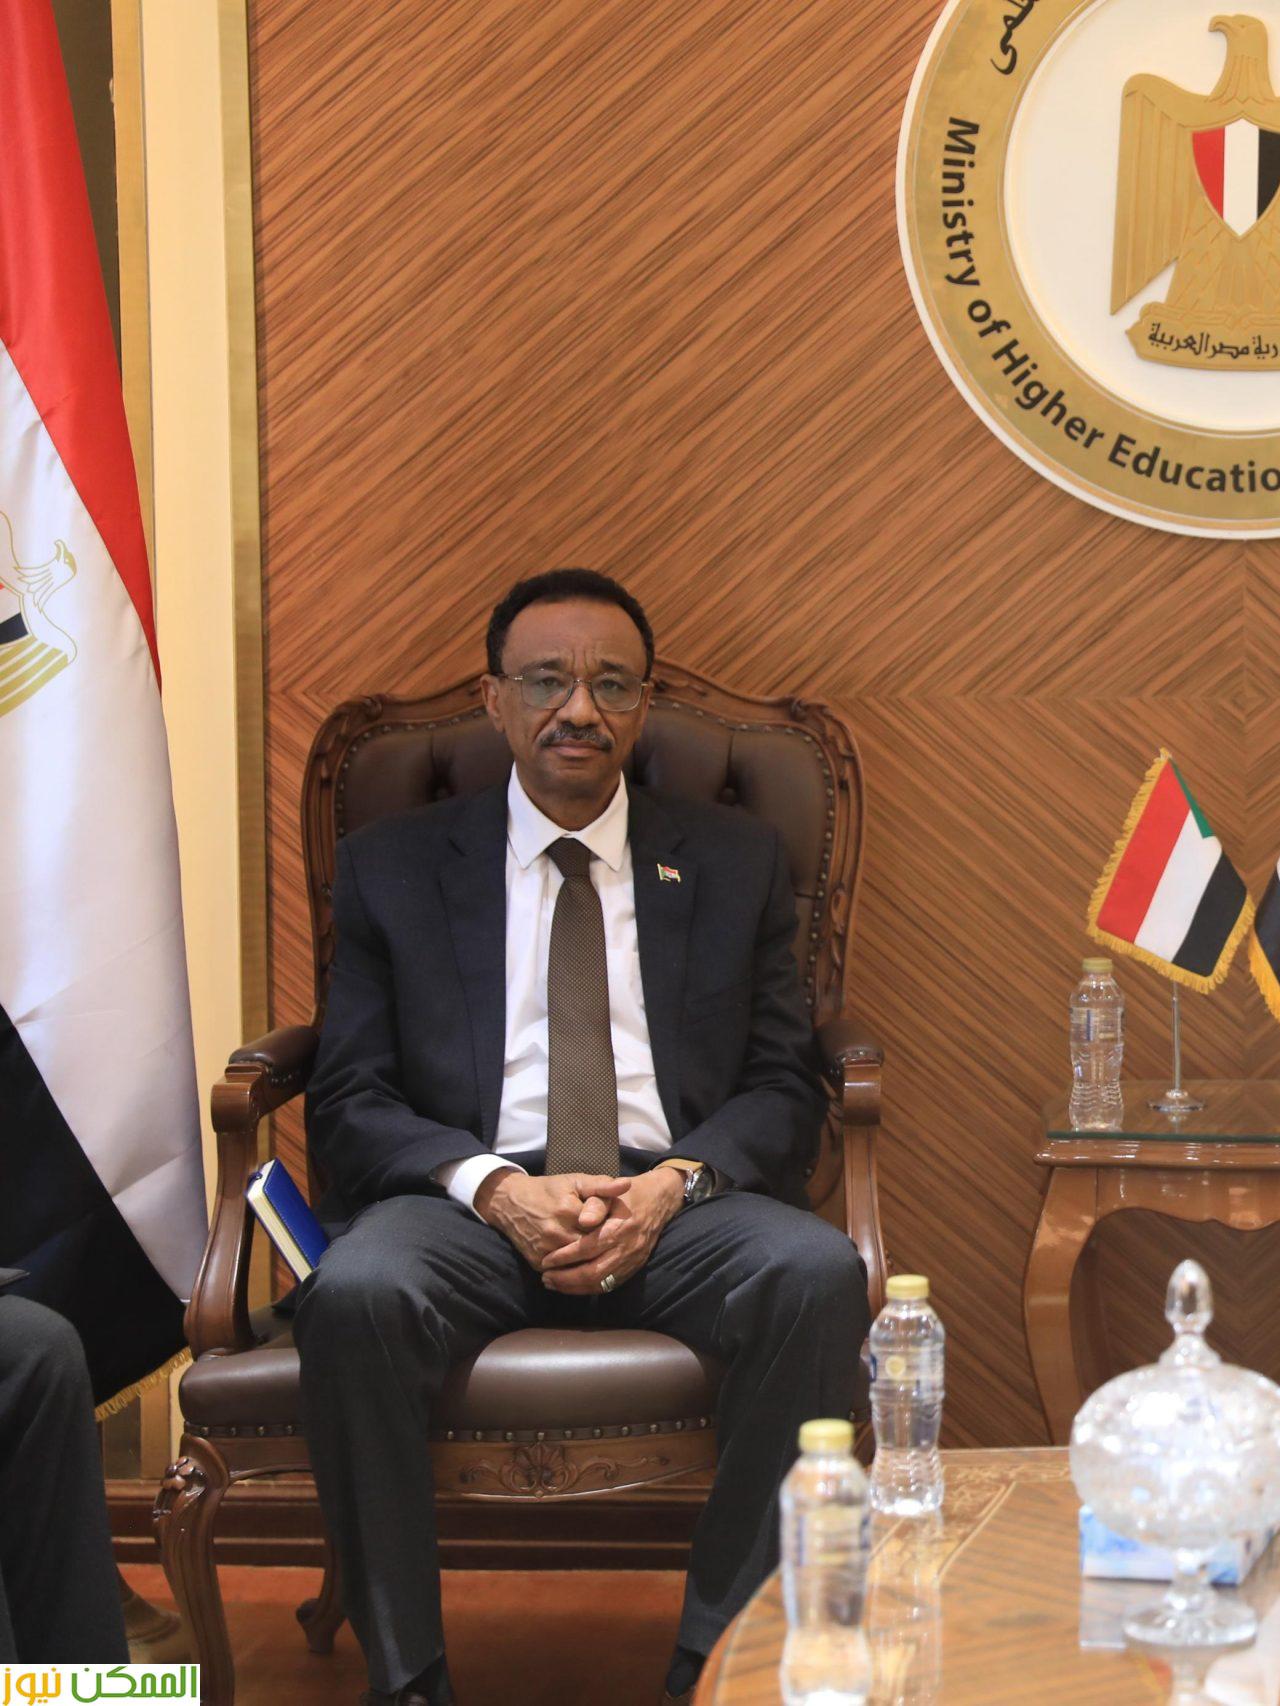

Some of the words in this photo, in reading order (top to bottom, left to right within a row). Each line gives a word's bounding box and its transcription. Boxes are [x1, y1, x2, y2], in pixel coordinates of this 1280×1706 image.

[941, 116, 981, 286] Ministry
[967, 299, 1011, 338] of
[991, 338, 1105, 449] Higher
[1148, 322, 1210, 356] العربية
[1208, 341, 1250, 360] مصر
